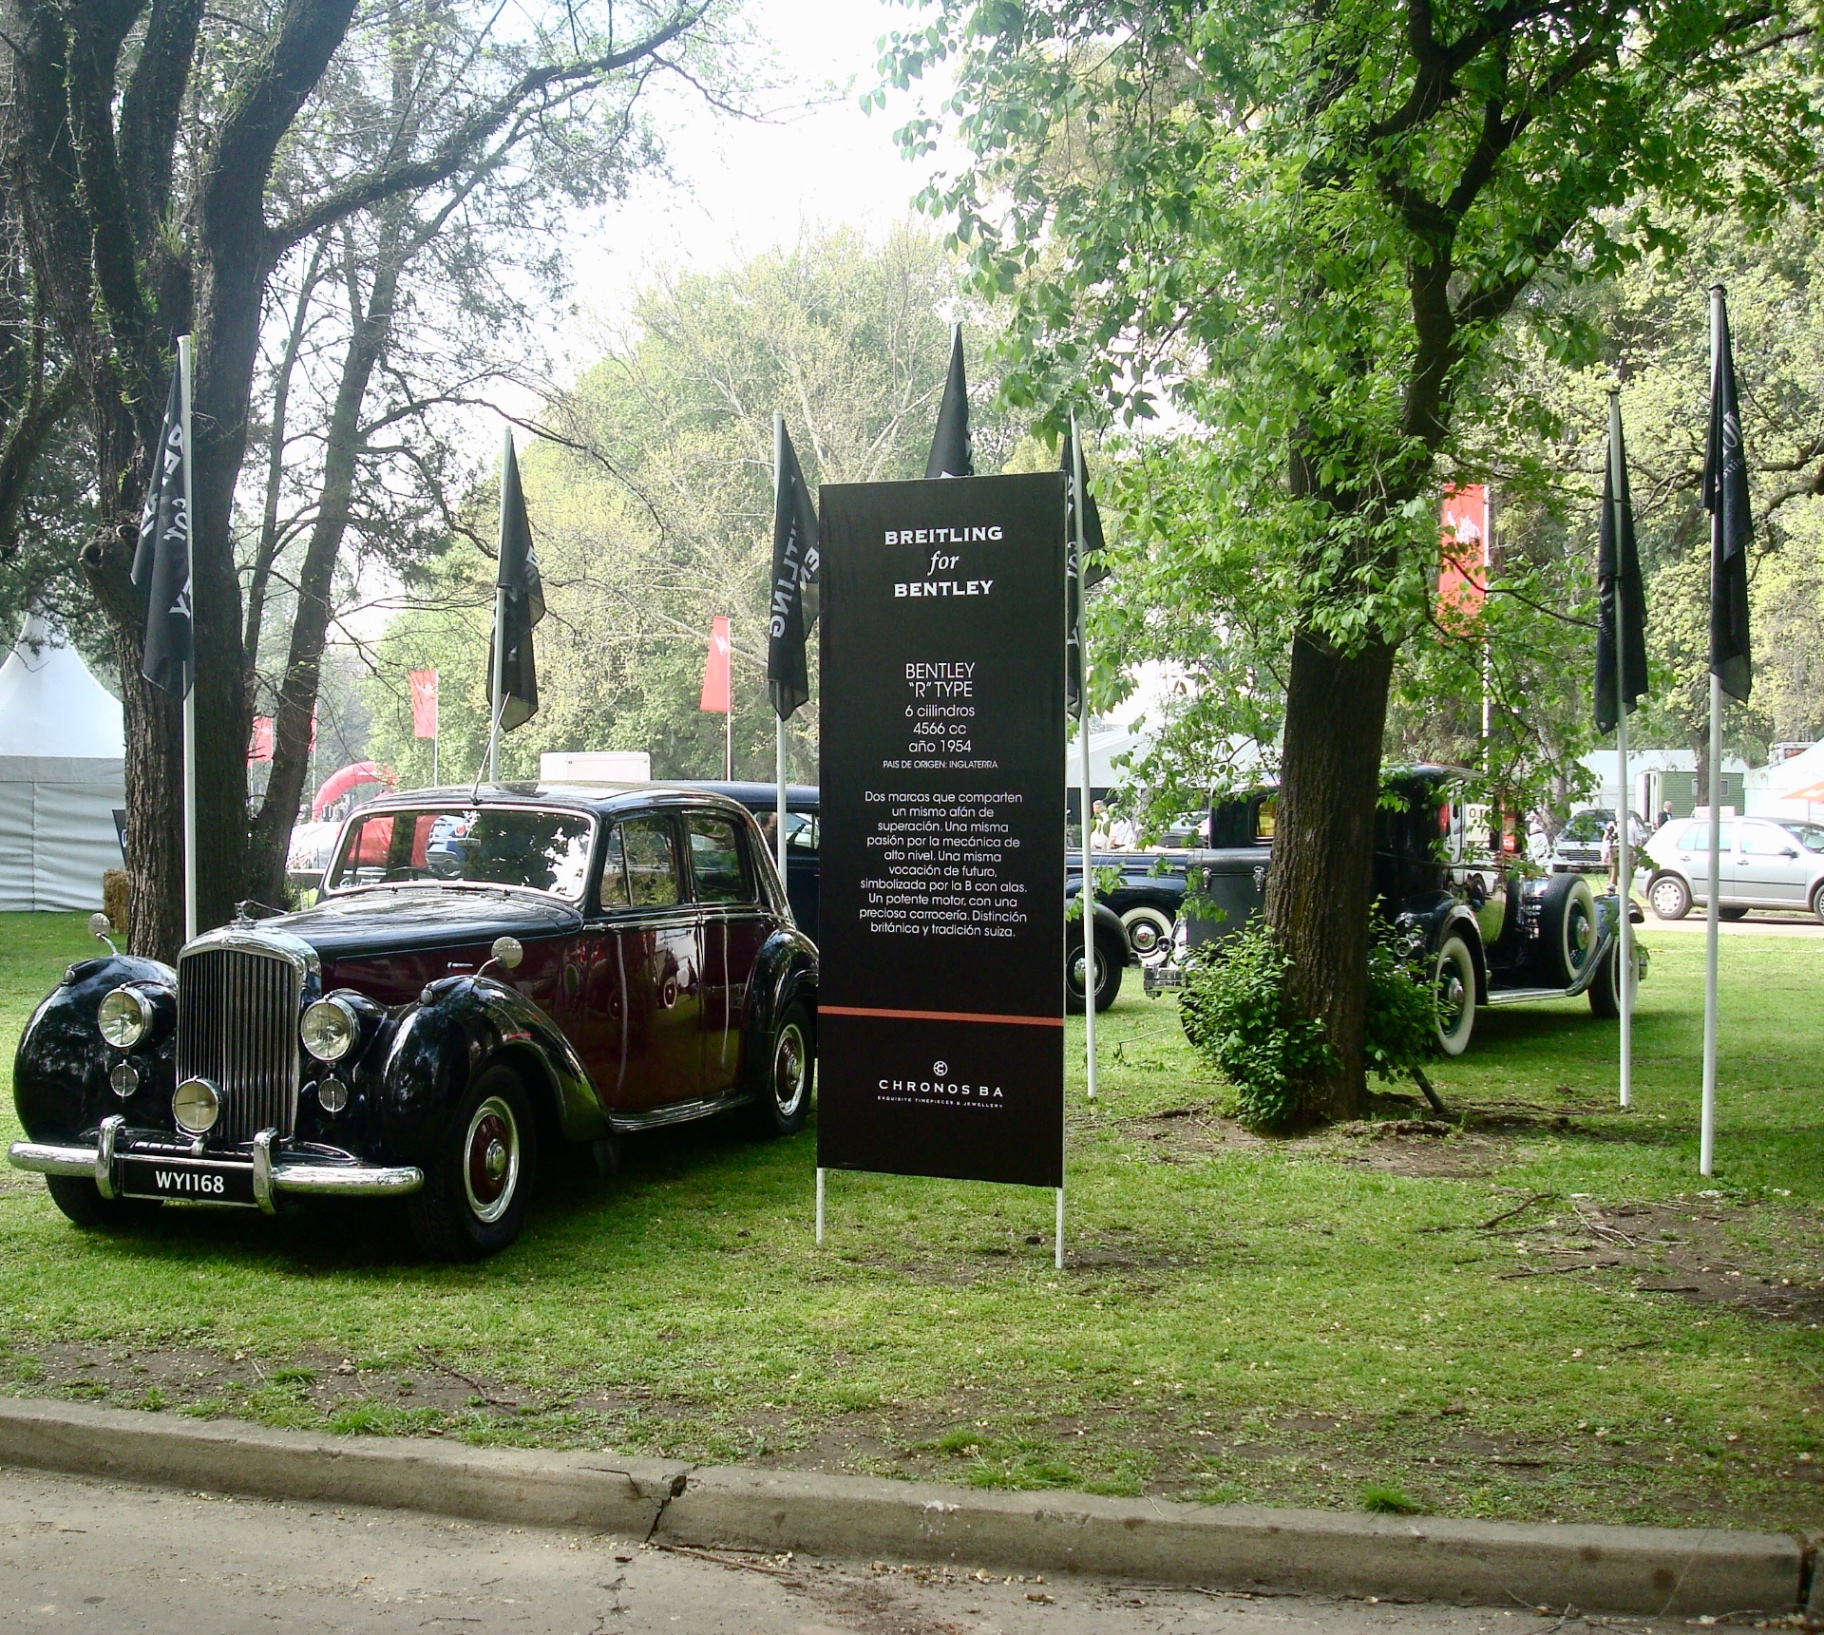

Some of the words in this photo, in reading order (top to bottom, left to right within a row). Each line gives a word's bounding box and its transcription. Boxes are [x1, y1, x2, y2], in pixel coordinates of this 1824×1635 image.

[884, 526, 1003, 545] BREITLING
[927, 550, 960, 576] for
[894, 580, 993, 597] BENTLEY
[906, 662, 975, 679] BENTLEY
[934, 681, 972, 697] TYPE
[905, 705, 913, 717] 6
[913, 722, 945, 734] 4566
[949, 725, 966, 734] cc
[909, 740, 936, 752] año
[940, 740, 971, 752] 1954
[901, 760, 912, 768] DE
[914, 760, 947, 768] ORIGEN:
[949, 760, 998, 768] INGLATERRA
[865, 791, 885, 801] Dos
[889, 794, 930, 802] marcas
[933, 794, 955, 804] que
[958, 792, 1022, 805] comparten
[892, 808, 906, 816] un
[910, 806, 946, 817] mismo
[949, 806, 975, 817] afán
[979, 807, 994, 817] de
[878, 821, 942, 833] superación.
[945, 821, 967, 831] Una
[971, 822, 1008, 832] misma
[867, 835, 904, 847] pasión
[907, 837, 926, 848] por
[930, 836, 939, 846] la
[943, 836, 1001, 847] mecánica
[1004, 837, 1020, 847] de
[884, 850, 905, 860] alto
[908, 850, 935, 860] nivel.
[938, 851, 960, 861] Una
[964, 851, 1001, 862] misma
[889, 864, 941, 875] vocación
[944, 865, 959, 876] de
[962, 865, 997, 877] futuro,
[861, 878, 926, 889] simbolizada
[930, 882, 948, 892] por
[952, 880, 961, 890] la
[965, 880, 972, 891] B
[975, 883, 997, 891] con
[1000, 882, 1027, 892] alas.
[869, 893, 883, 903] Un
[886, 894, 929, 905] potente
[932, 895, 966, 906] motor,
[969, 898, 991, 906] con
[995, 899, 1017, 907] una
[860, 908, 906, 919] preciosa
[910, 910, 969, 920] carrocería.
[973, 910, 1027, 922] Distinción
[871, 922, 919, 933] británica
[923, 926, 929, 936] y
[932, 924, 981, 935] tradición
[984, 926, 1015, 937] suiza.
[879, 1080, 970, 1094] CHRONOS
[980, 1086, 1003, 1097] BA
